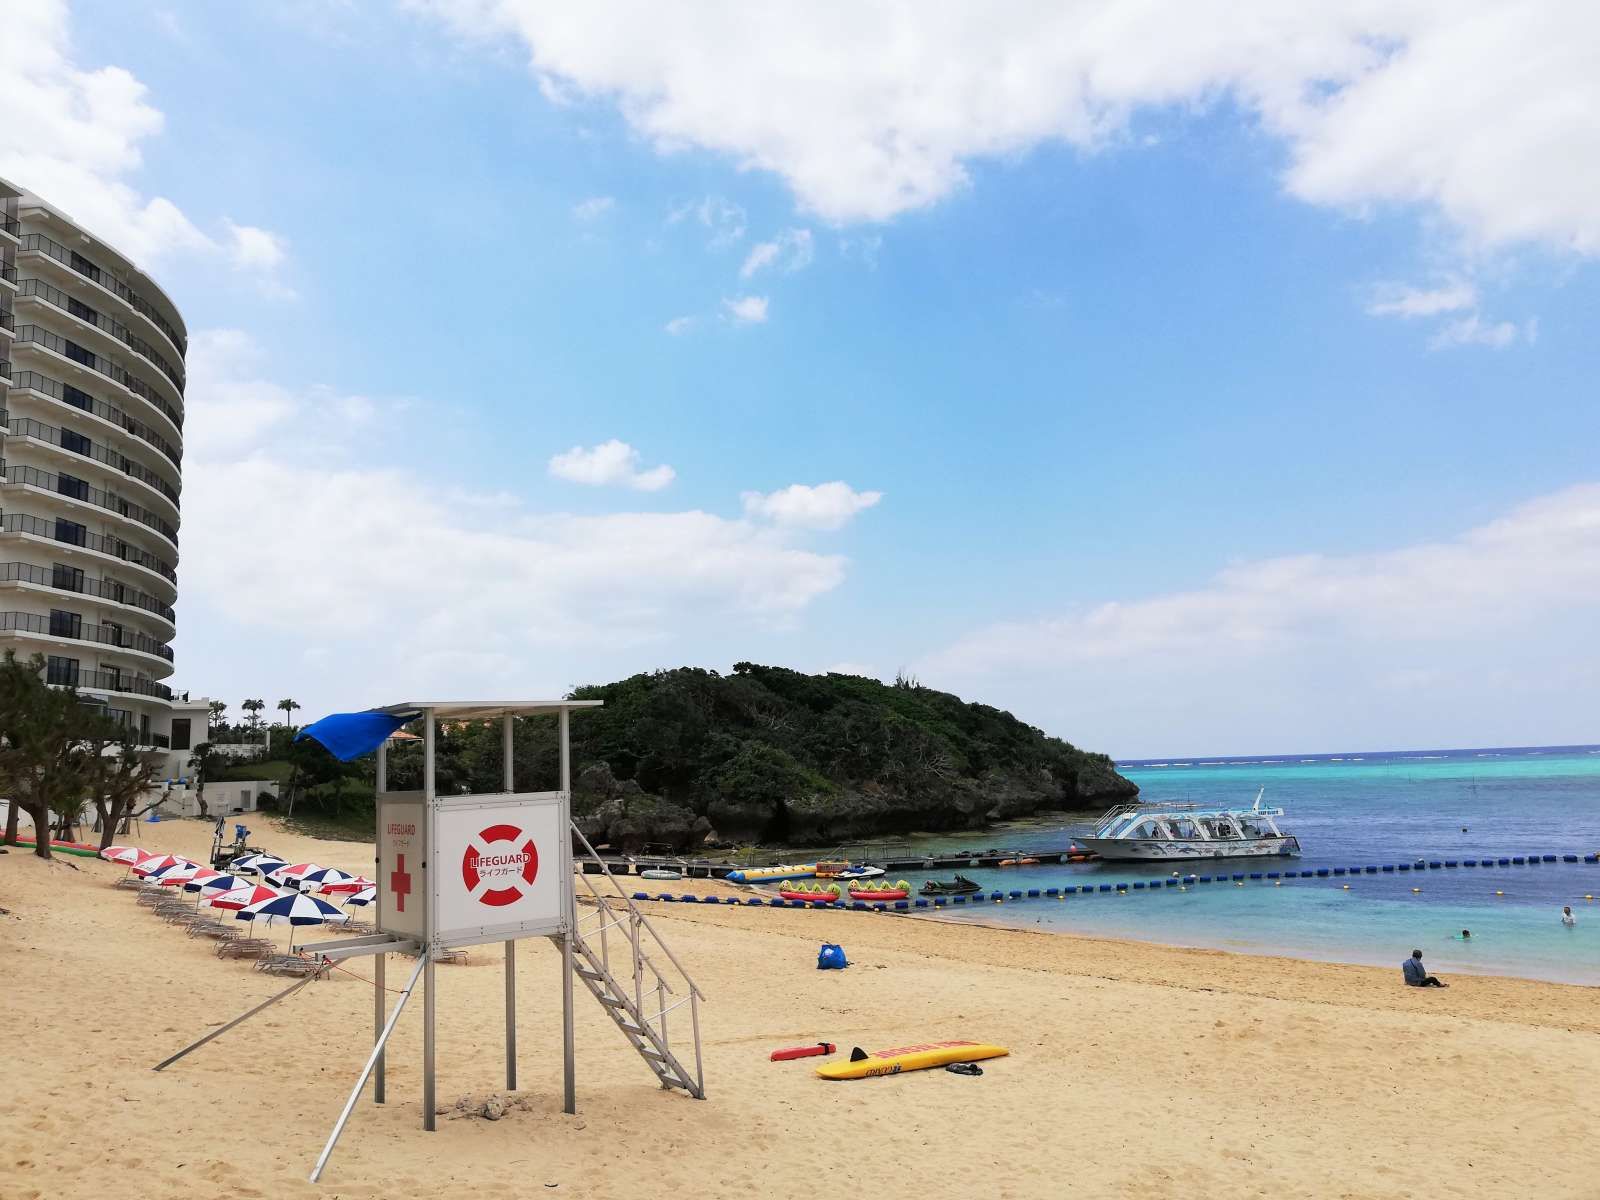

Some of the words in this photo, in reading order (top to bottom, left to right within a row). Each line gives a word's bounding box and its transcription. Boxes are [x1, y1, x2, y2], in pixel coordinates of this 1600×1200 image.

[387, 824, 416, 835] LIFEGUARD
[470, 853, 531, 868] LIFEGUARD
[479, 866, 522, 878] ライフガード
